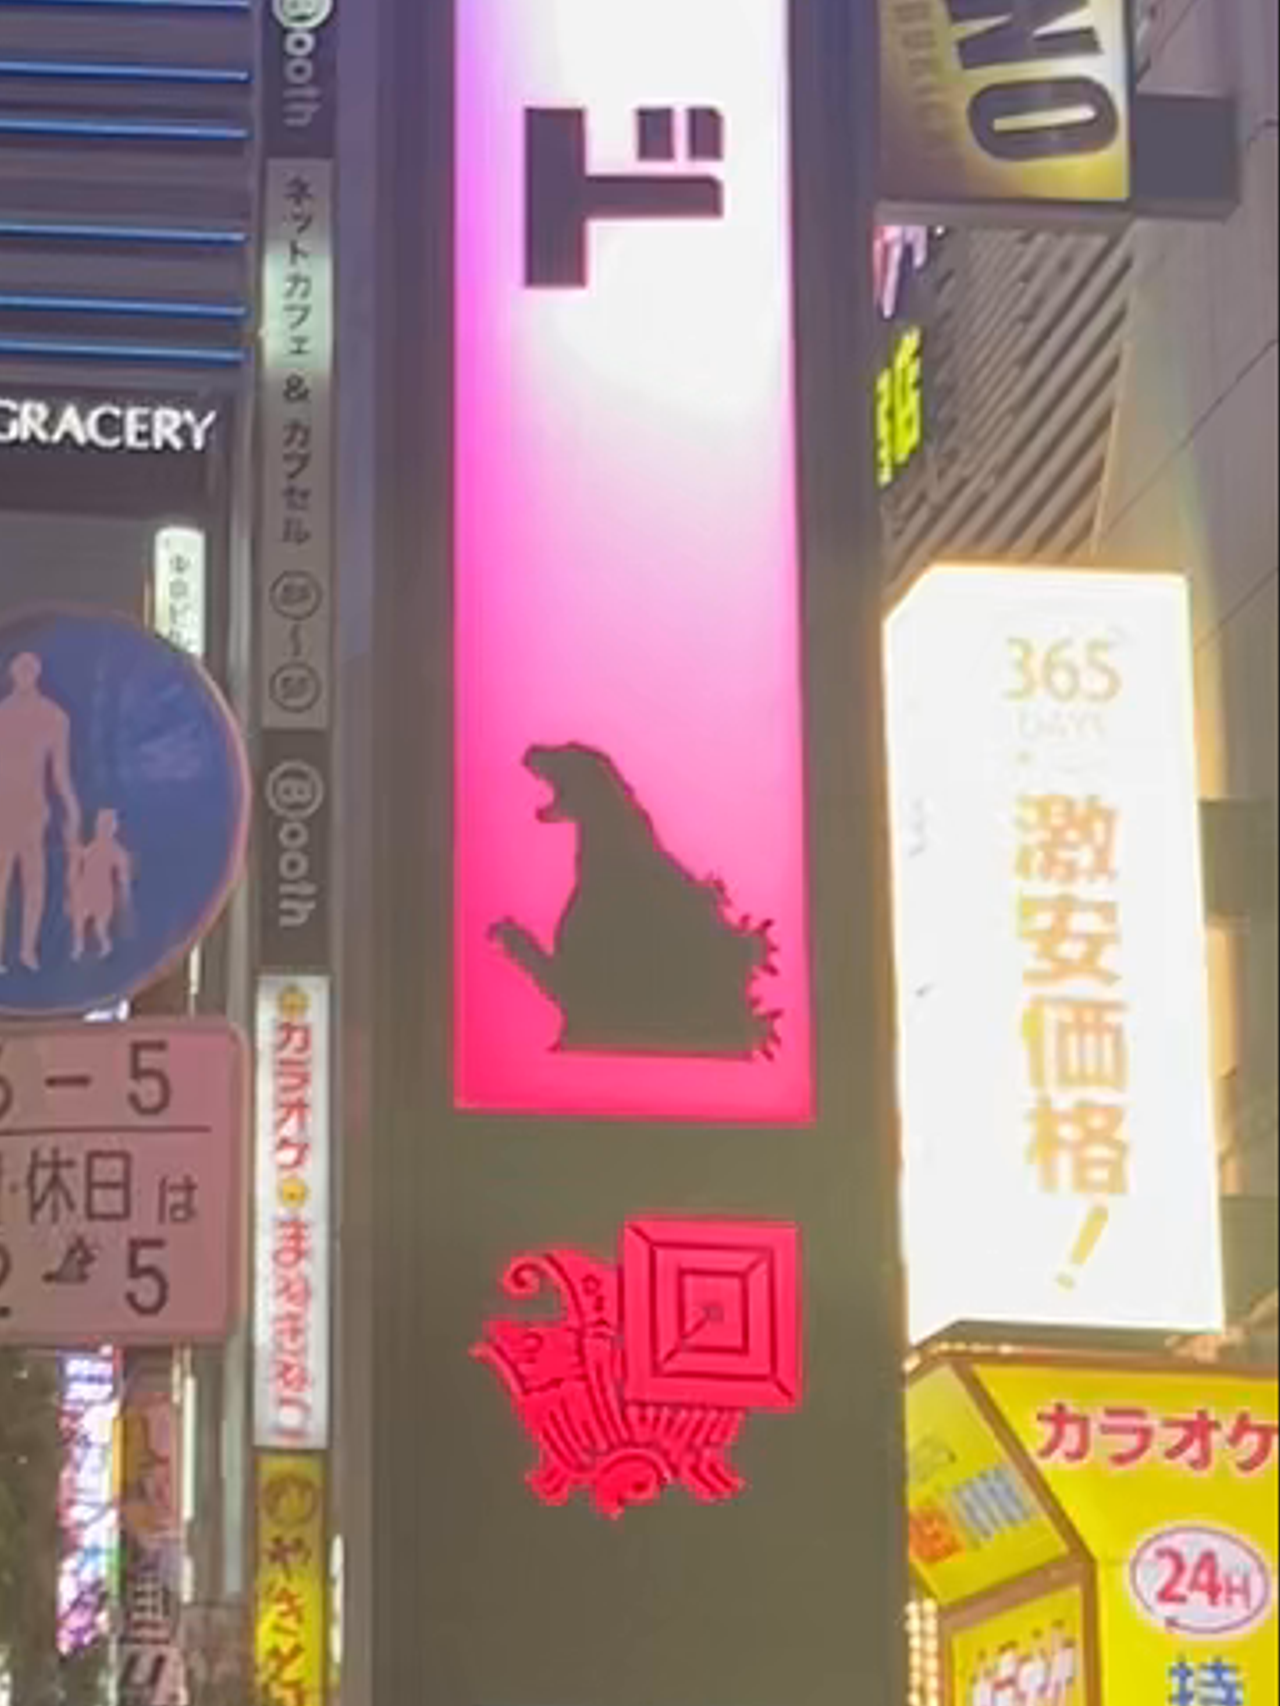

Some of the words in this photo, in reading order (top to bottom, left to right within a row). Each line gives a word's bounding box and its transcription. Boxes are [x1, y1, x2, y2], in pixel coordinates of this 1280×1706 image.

[1036, 1401, 1280, 1474] カラオケ
[1153, 1546, 1253, 1609] 24H
